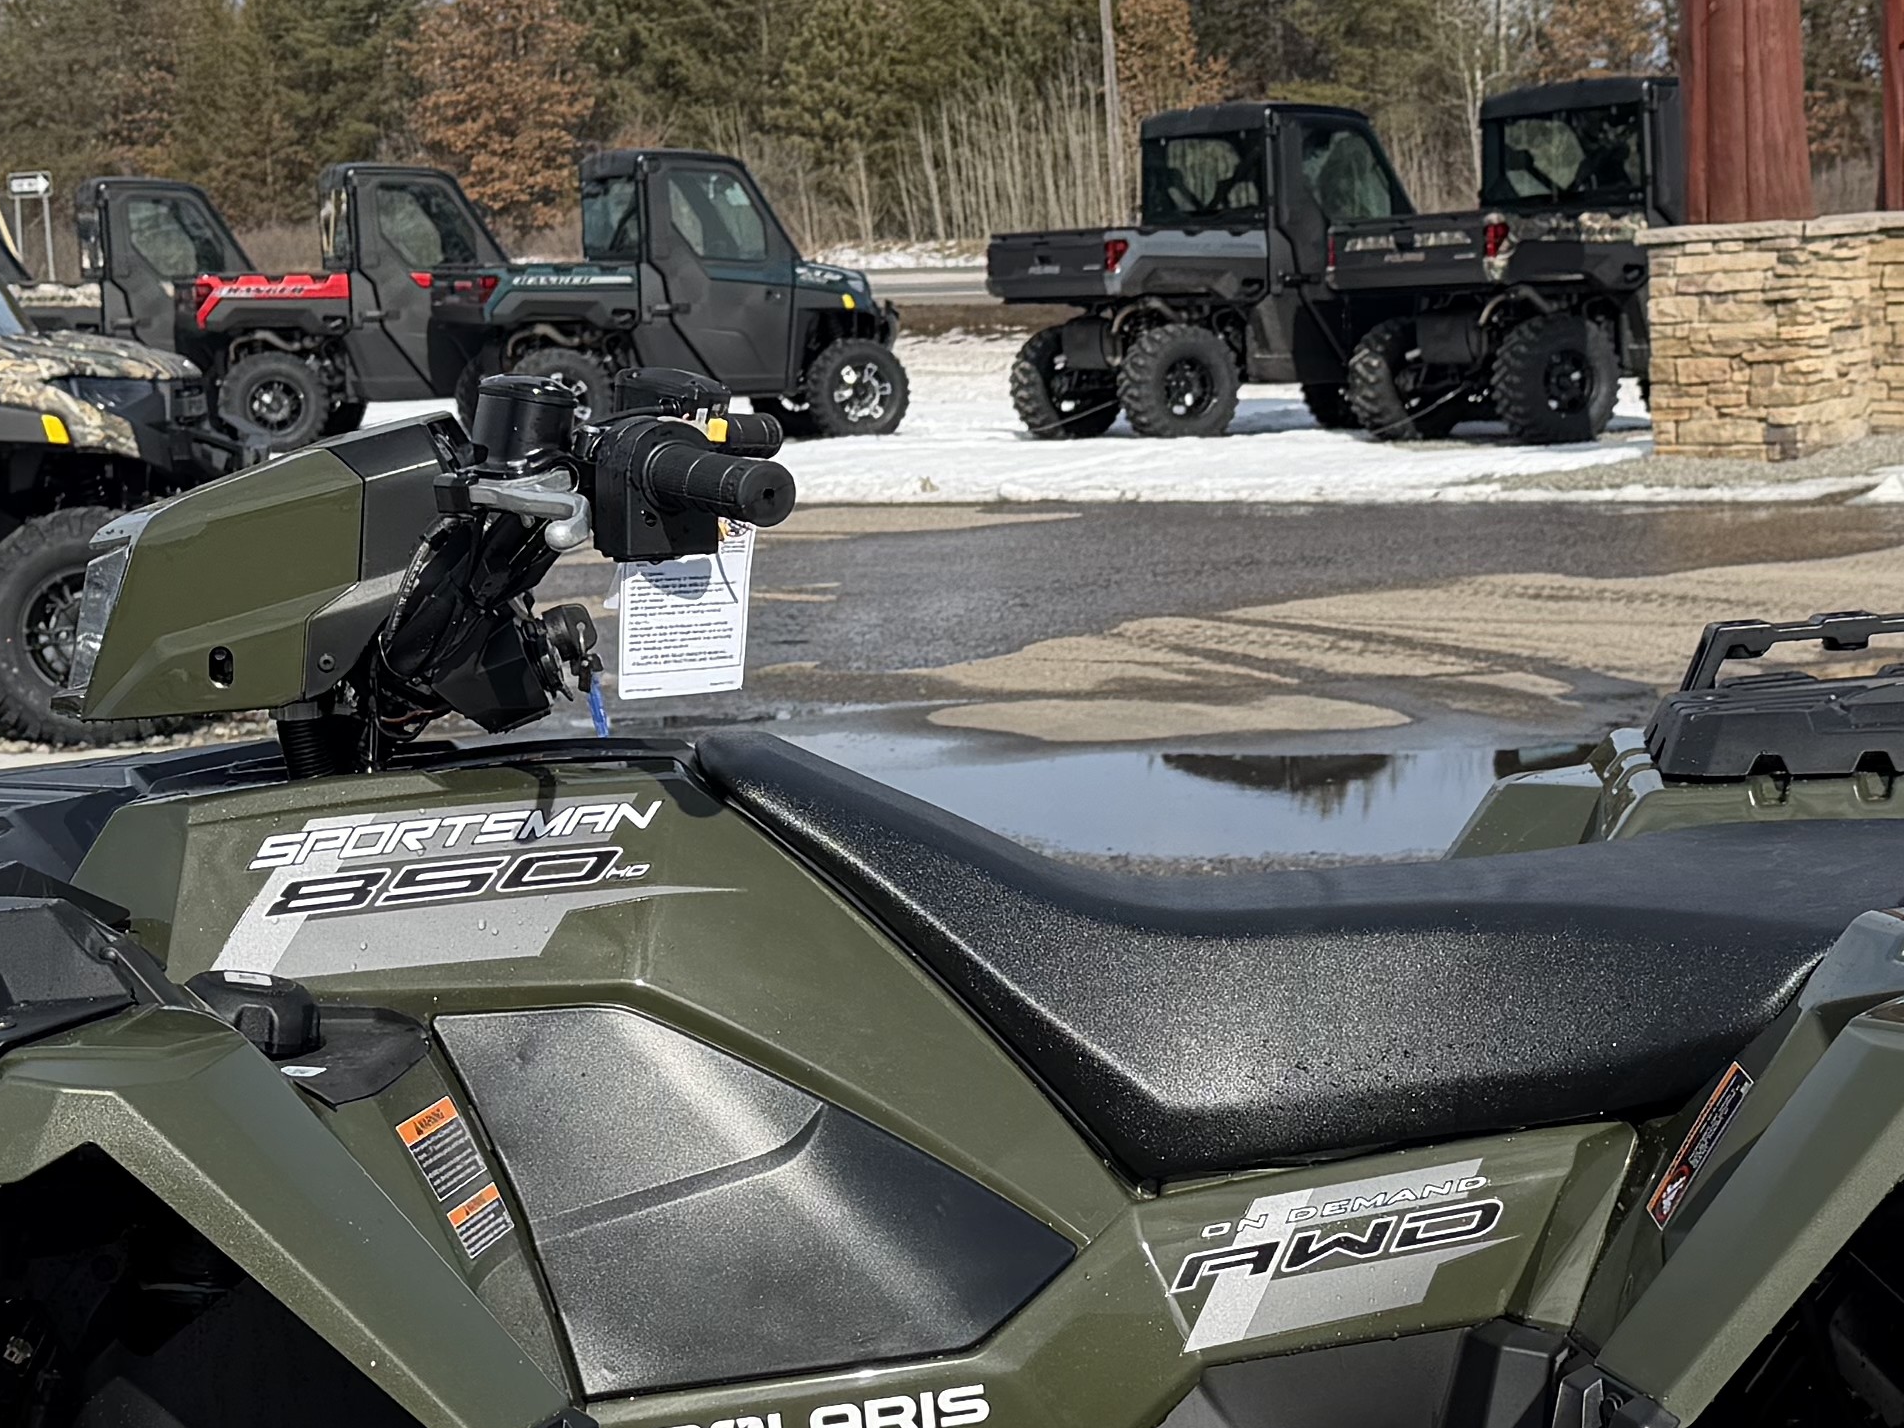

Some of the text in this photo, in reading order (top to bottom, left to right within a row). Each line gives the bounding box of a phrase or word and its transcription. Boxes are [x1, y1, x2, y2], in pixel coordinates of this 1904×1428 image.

[248, 799, 664, 870] SPORTSMAN
[264, 846, 623, 918] 850
[1201, 1175, 1490, 1239] ON DEMAND
[1171, 1198, 1505, 1294] AWD
